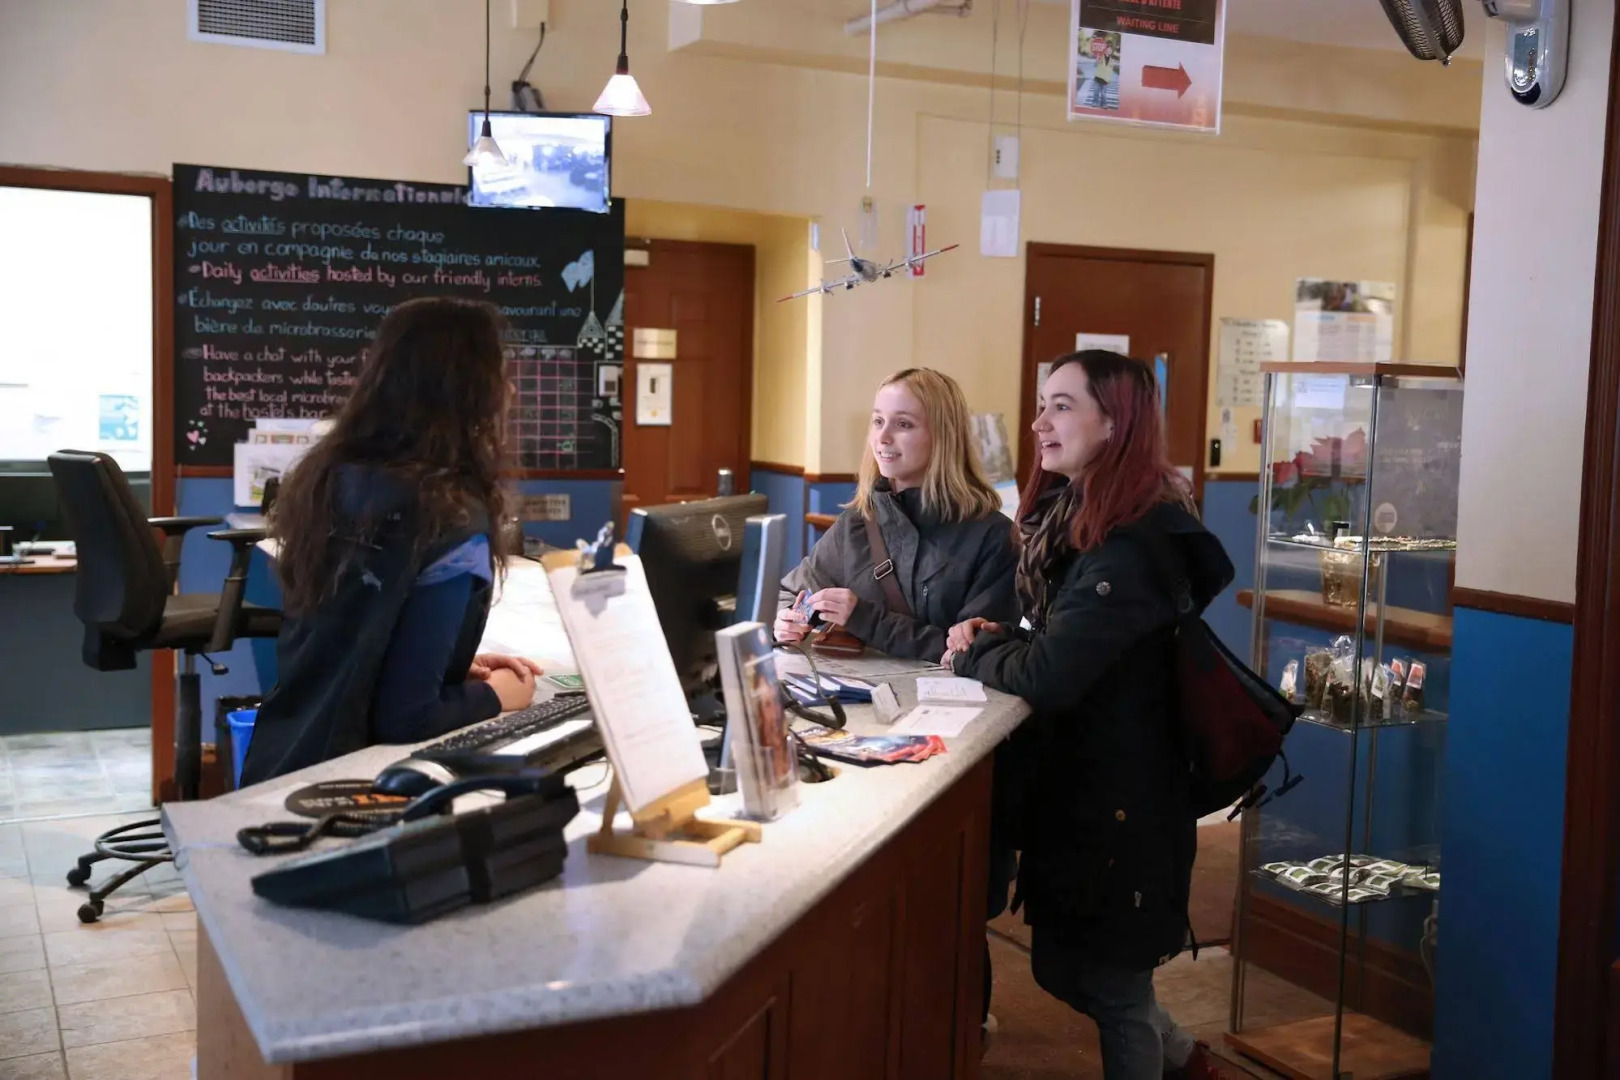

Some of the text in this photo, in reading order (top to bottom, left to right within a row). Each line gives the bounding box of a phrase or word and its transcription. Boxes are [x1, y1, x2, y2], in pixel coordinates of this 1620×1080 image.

[1116, 15, 1180, 33] WAITING LINE
[1092, 42, 1107, 51] STOP
[195, 168, 299, 200] Auberge
[291, 221, 381, 241] proposées
[387, 222, 445, 247] chaque
[187, 238, 230, 258] jour
[237, 242, 258, 255] en
[265, 244, 354, 265] compagnie
[382, 251, 408, 263] nos
[412, 247, 481, 270] stagiaires
[202, 260, 242, 285] Daily
[250, 262, 320, 283] activities
[326, 264, 373, 283] hosted
[377, 264, 395, 288] by
[402, 272, 428, 284] our
[433, 267, 491, 292] friendly
[261, 299, 297, 312] avec
[194, 314, 238, 334] bière
[202, 344, 239, 361] Have
[243, 351, 254, 361] a
[256, 345, 286, 362] chat
[290, 348, 322, 364] with
[326, 354, 357, 368] your
[203, 366, 284, 385] backpackers
[289, 370, 323, 385] while
[206, 385, 227, 400] the
[228, 388, 257, 401] best
[258, 391, 288, 403] local
[199, 402, 213, 417] at
[217, 404, 240, 419] the
